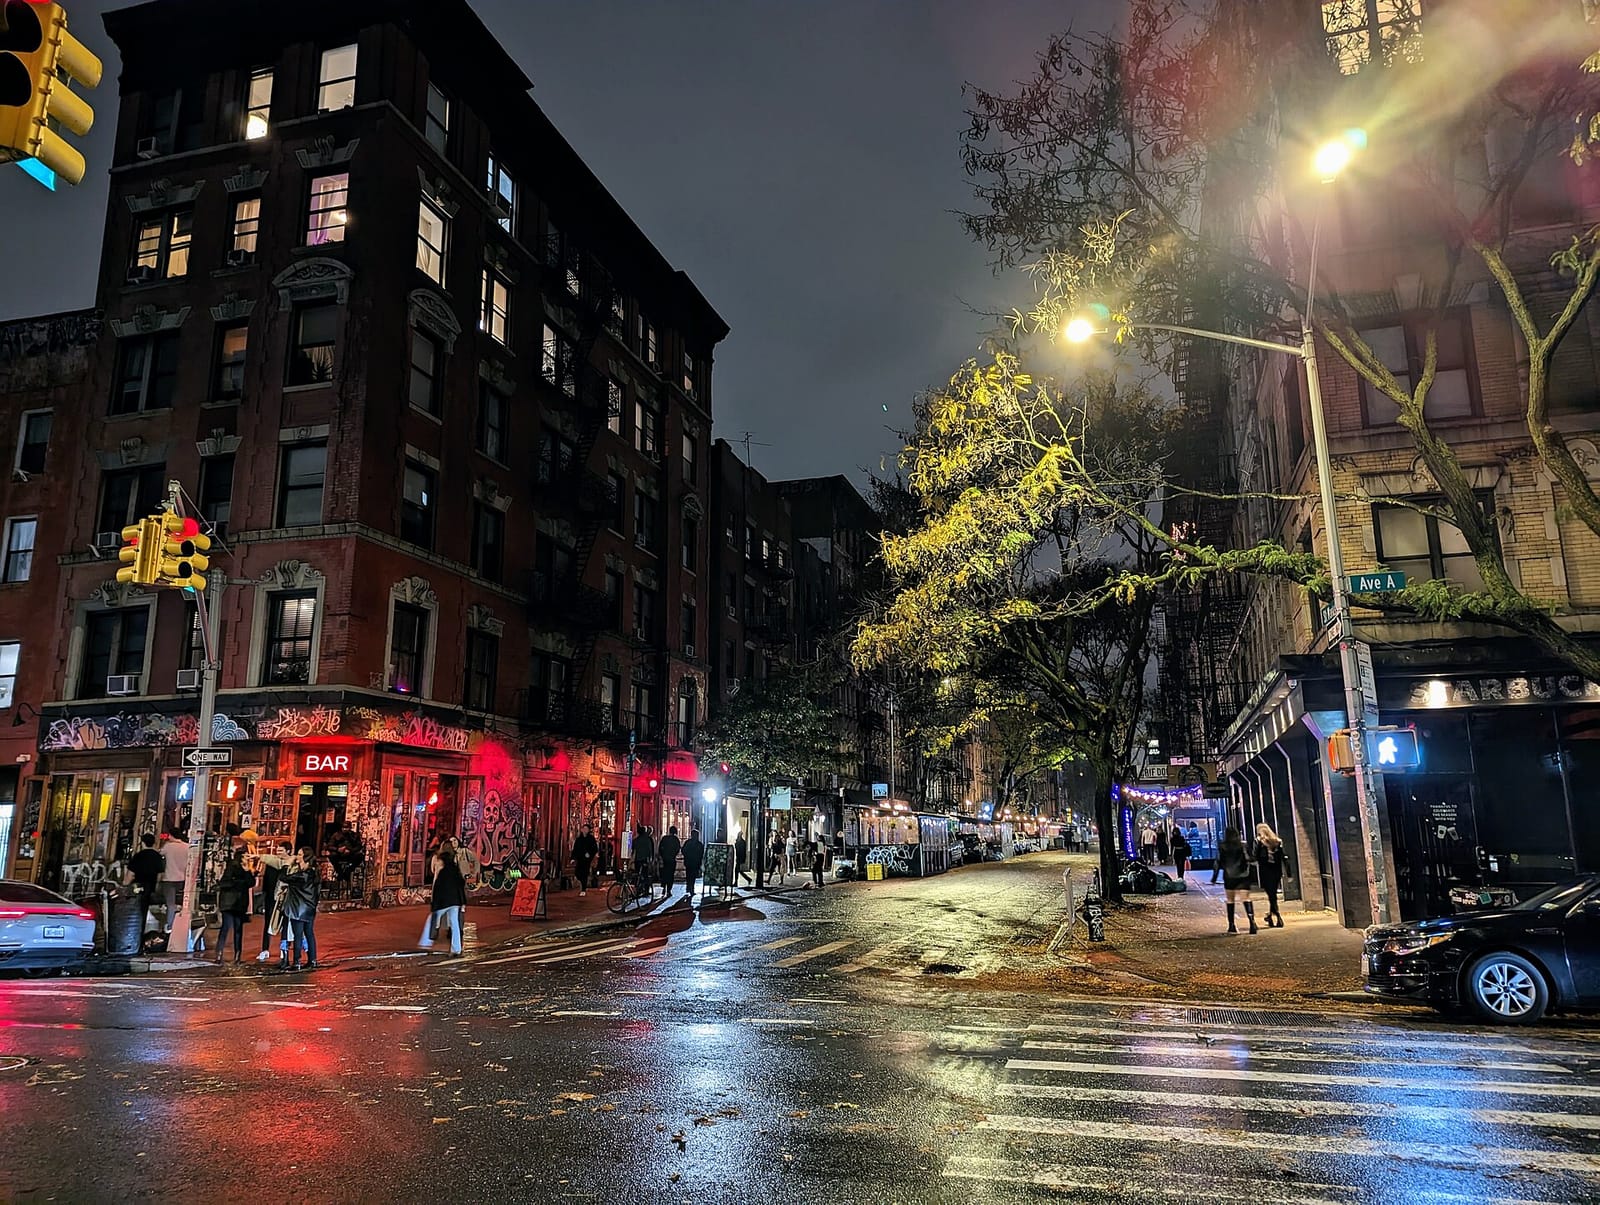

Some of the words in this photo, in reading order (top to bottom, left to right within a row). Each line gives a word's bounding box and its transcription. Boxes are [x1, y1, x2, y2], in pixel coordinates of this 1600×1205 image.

[1360, 576, 1381, 591] Ave
[1386, 574, 1396, 589] A
[191, 753, 208, 761] ONE
[213, 753, 227, 761] WAY
[305, 755, 349, 771] BAR
